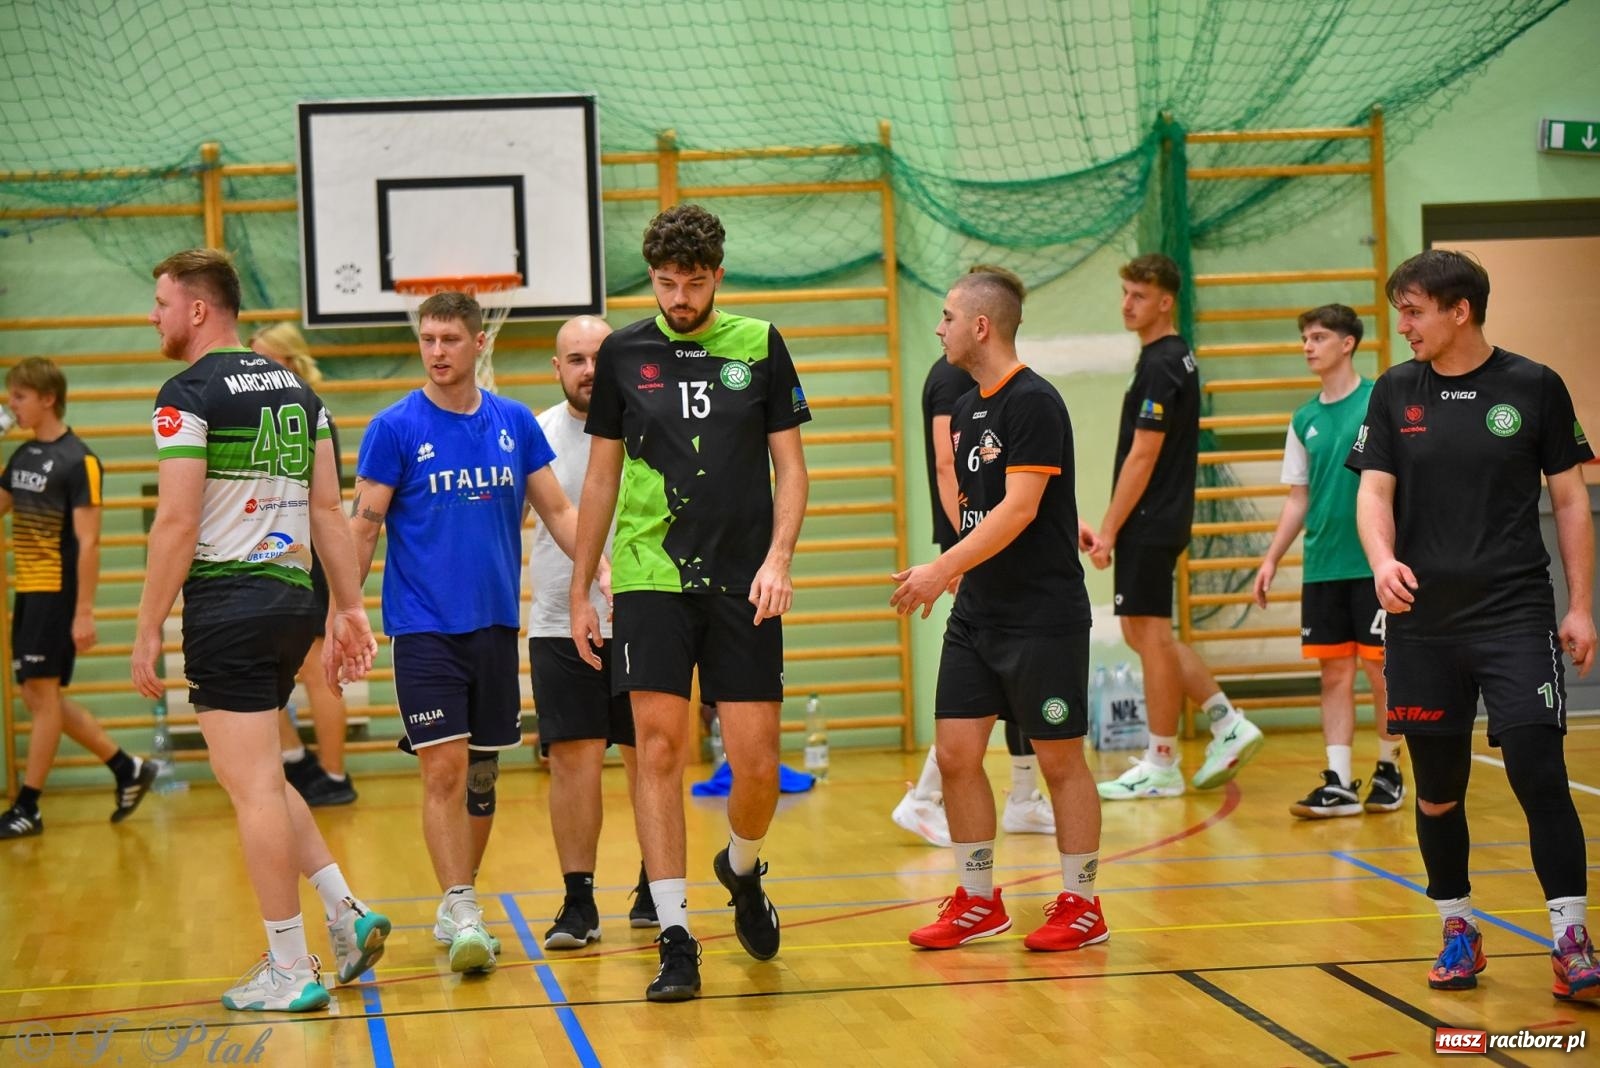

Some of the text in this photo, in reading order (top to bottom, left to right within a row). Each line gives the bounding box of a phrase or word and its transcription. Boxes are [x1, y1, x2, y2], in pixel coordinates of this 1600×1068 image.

[678, 381, 711, 419] 13
[252, 403, 309, 477] 49
[967, 445, 980, 472] 6
[429, 466, 514, 494] ITALIA
[1369, 608, 1387, 641] 4
[1537, 682, 1554, 709] 1
[409, 708, 445, 724] ITALIA
